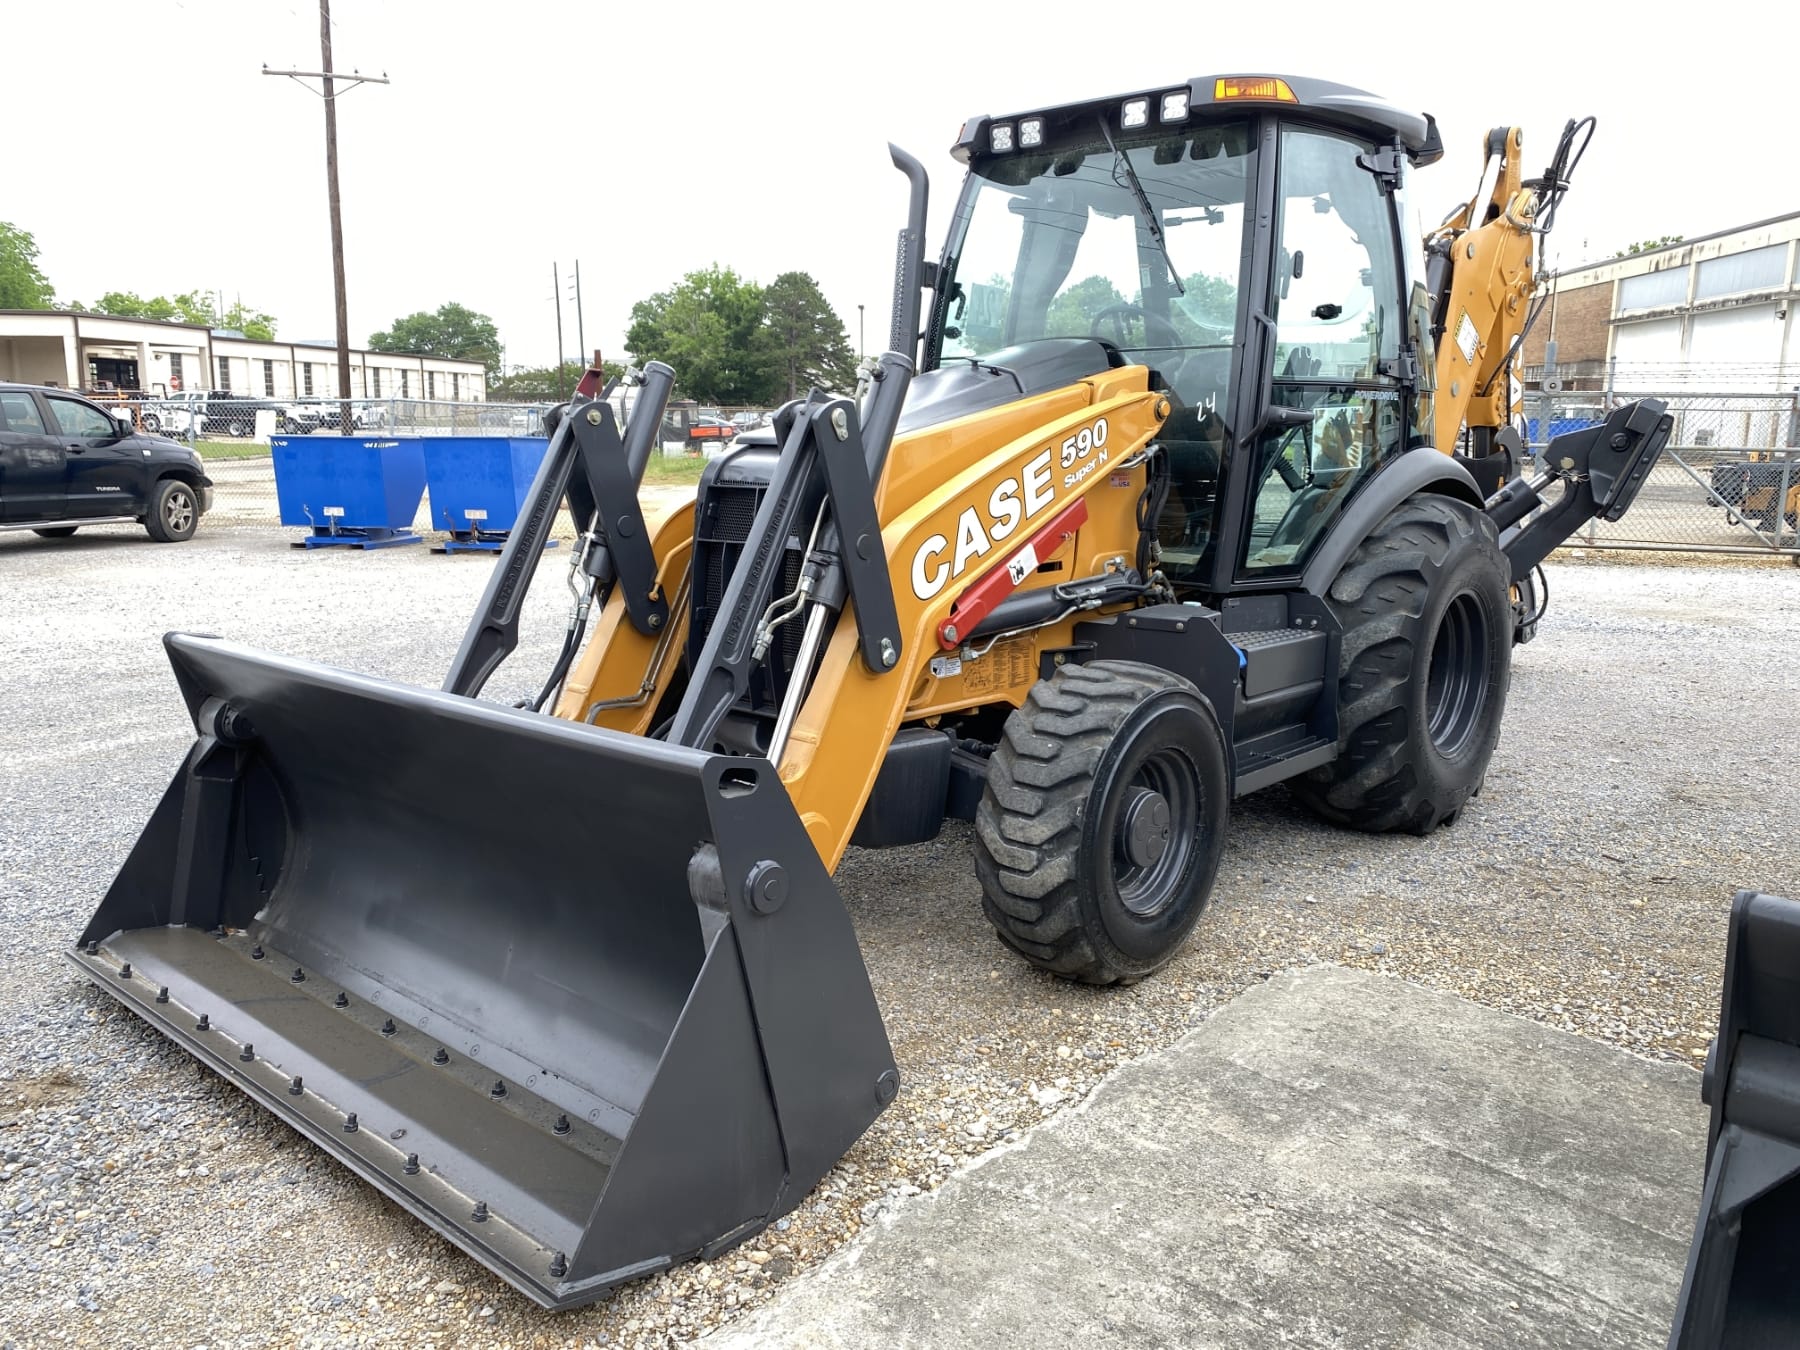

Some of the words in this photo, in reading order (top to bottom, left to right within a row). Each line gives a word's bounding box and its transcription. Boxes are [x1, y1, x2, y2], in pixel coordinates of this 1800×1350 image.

[1196, 391, 1216, 422] 24
[1064, 458, 1097, 488] Super
[1098, 448, 1108, 464] N
[911, 447, 1056, 601] CASE
[1060, 417, 1109, 469] 590
